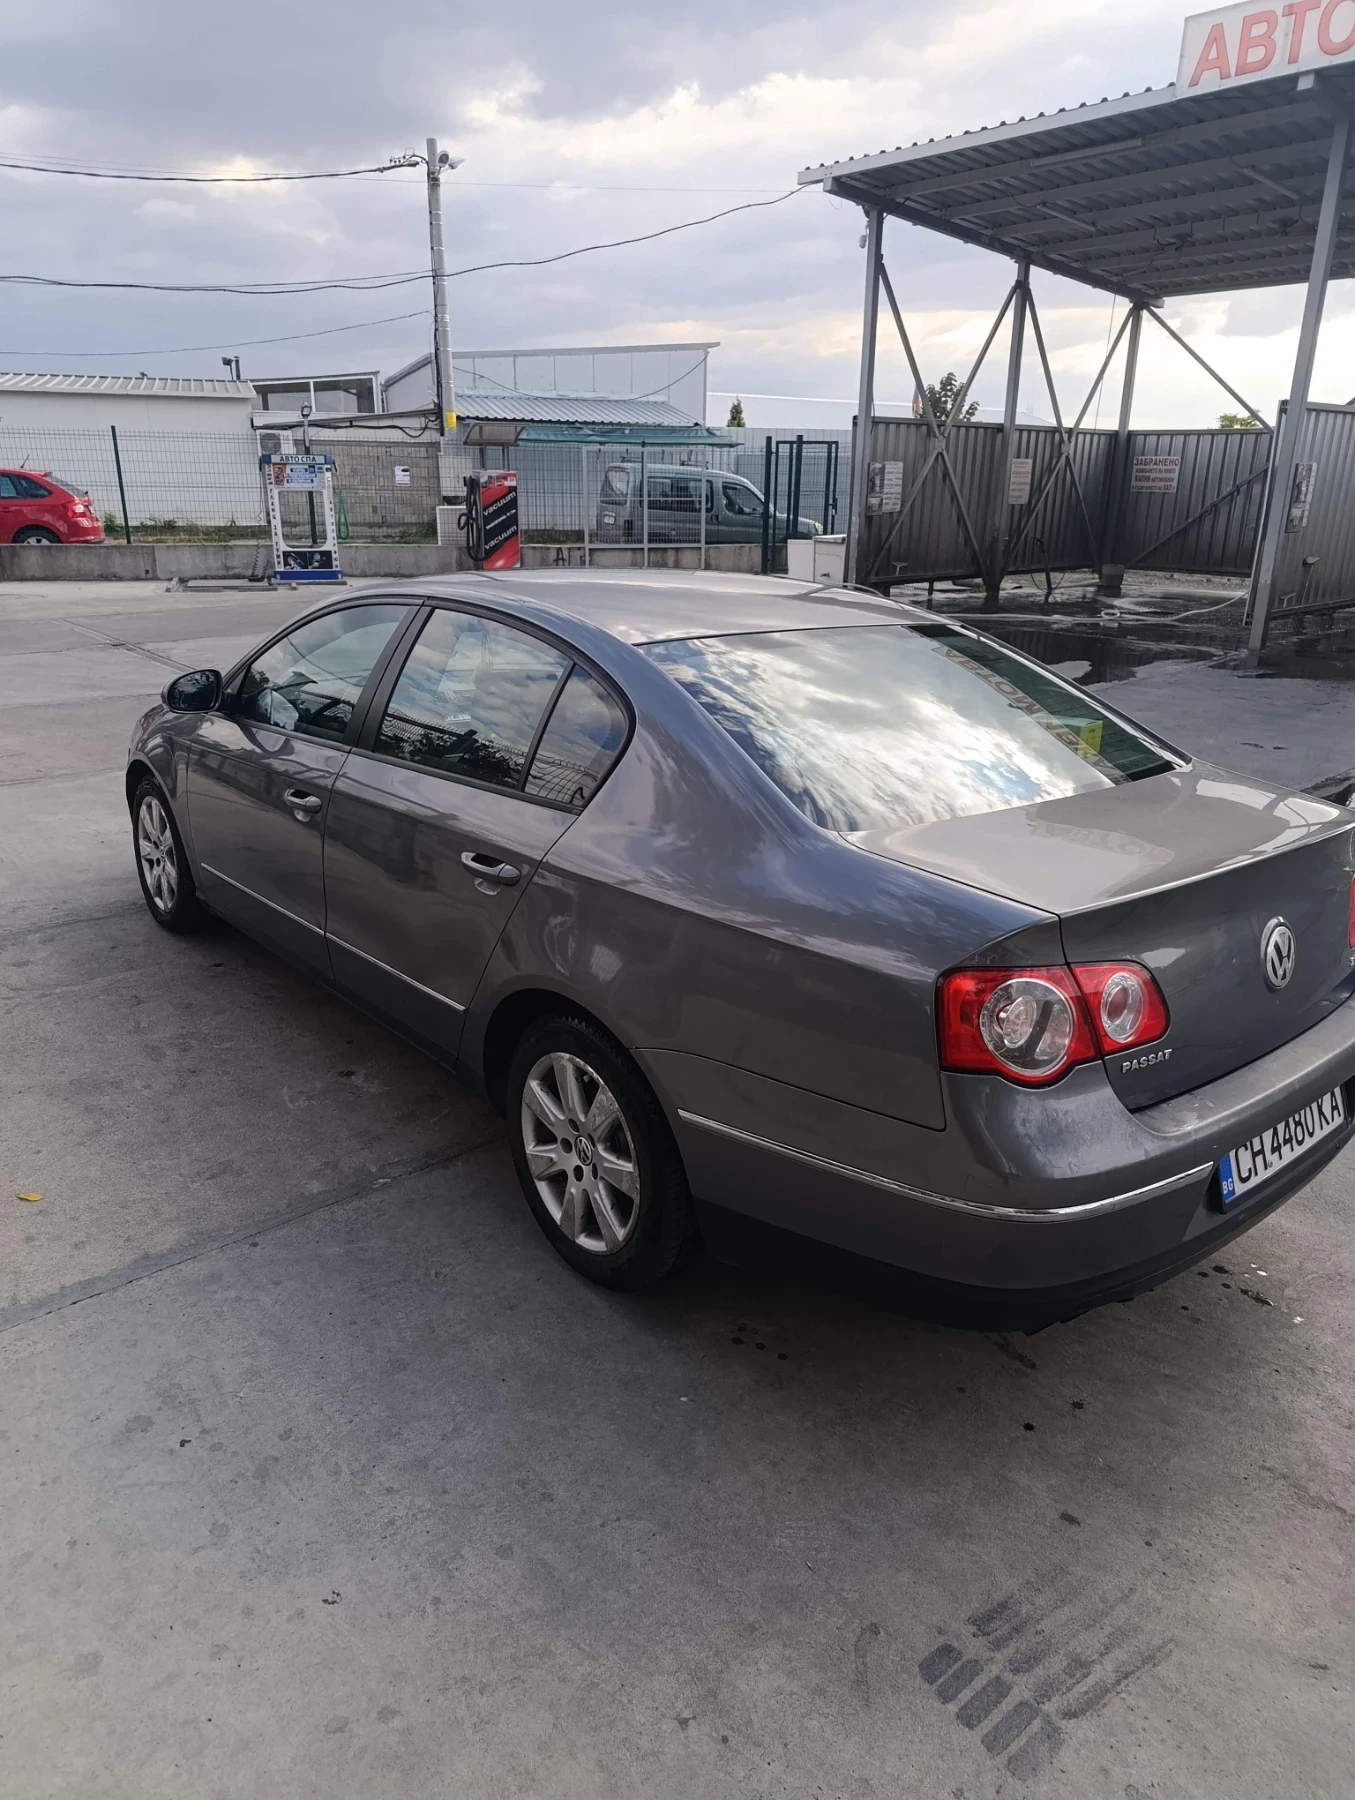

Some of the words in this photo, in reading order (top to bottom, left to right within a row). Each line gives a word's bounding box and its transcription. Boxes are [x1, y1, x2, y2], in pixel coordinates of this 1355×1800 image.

[280, 455, 300, 463] АВТО
[301, 455, 317, 463] СПА
[1134, 457, 1180, 467] ЗАБРАНЕНО
[483, 491, 517, 516] vacuum
[484, 525, 517, 550] vacuum
[1122, 1048, 1173, 1074] PASSAT
[1222, 1178, 1234, 1195] BG
